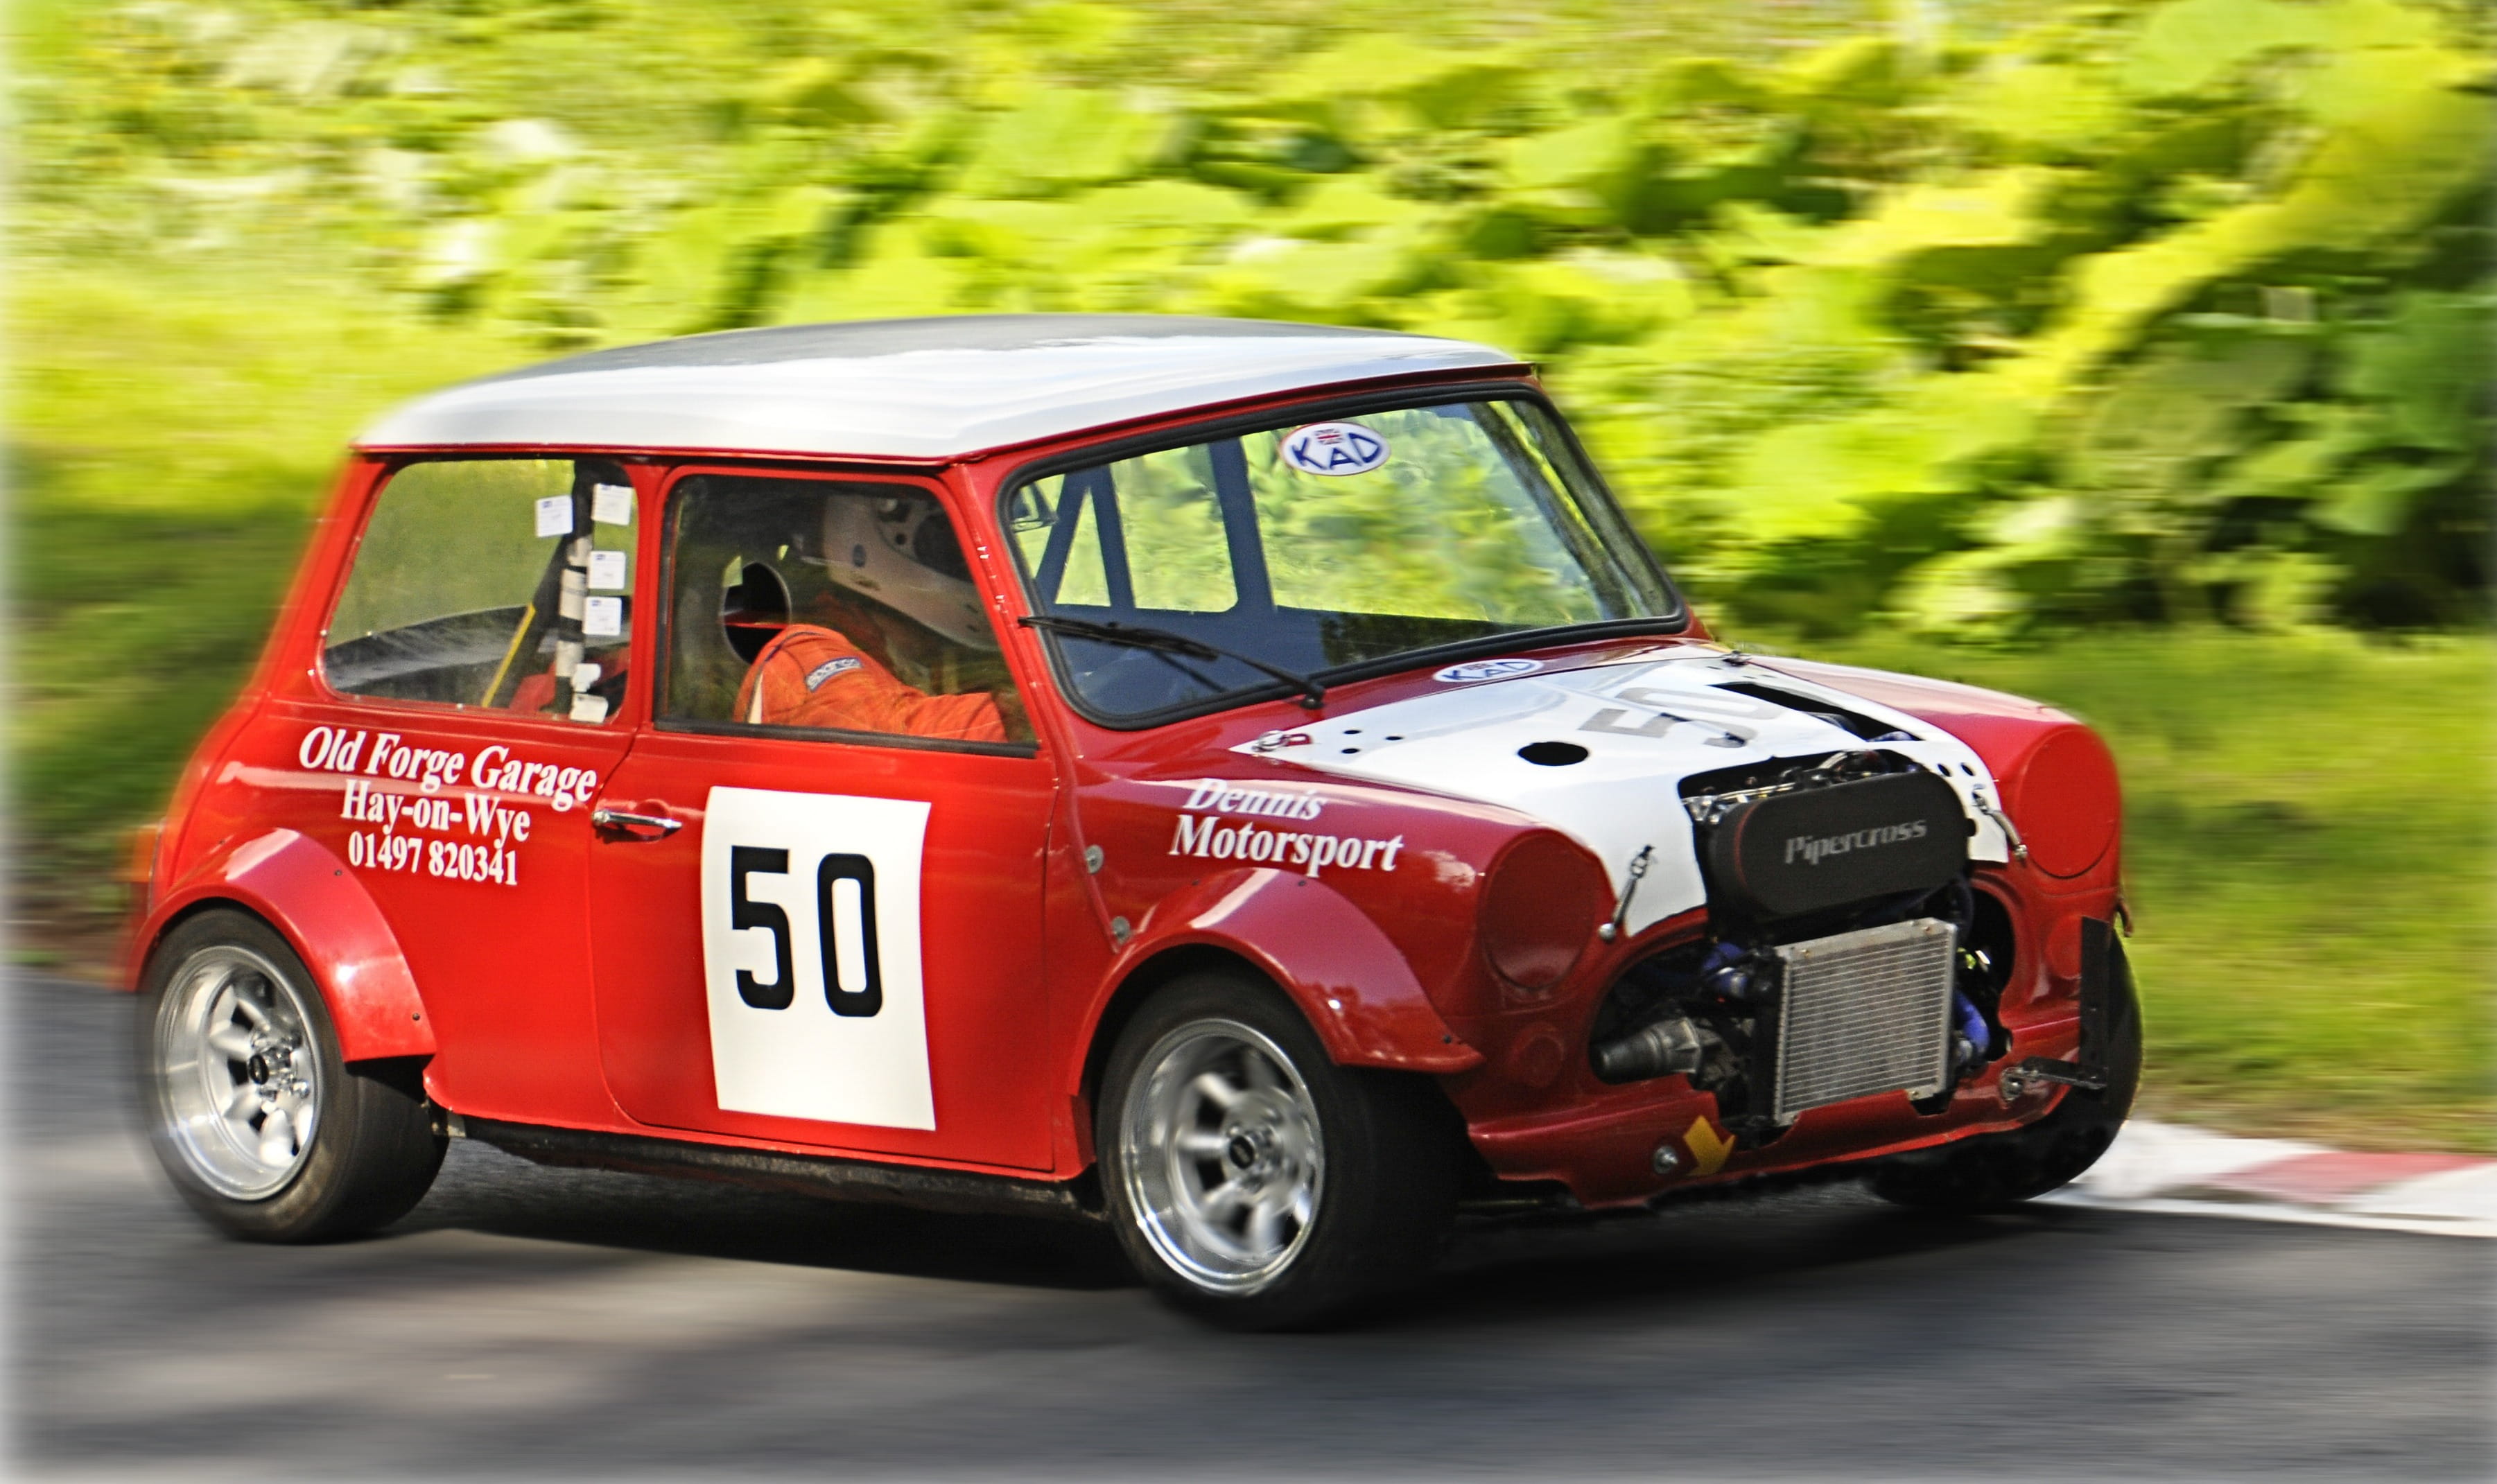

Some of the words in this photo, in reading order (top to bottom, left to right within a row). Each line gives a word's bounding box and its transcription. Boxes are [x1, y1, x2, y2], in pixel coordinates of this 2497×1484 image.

[1291, 432, 1382, 470] KAD
[1441, 661, 1535, 681] KAD
[1577, 687, 1786, 749] 50
[299, 726, 366, 771] Old
[364, 732, 465, 793] Forge
[471, 745, 598, 812] Garage
[340, 778, 531, 850] Hay-on-Wye
[1183, 778, 1327, 821] Dennis
[348, 830, 423, 873] 01497
[428, 839, 518, 886] 820341
[1168, 814, 1404, 878] Motorsport
[1784, 819, 1927, 865] Pipercross
[731, 844, 882, 1018] 50
